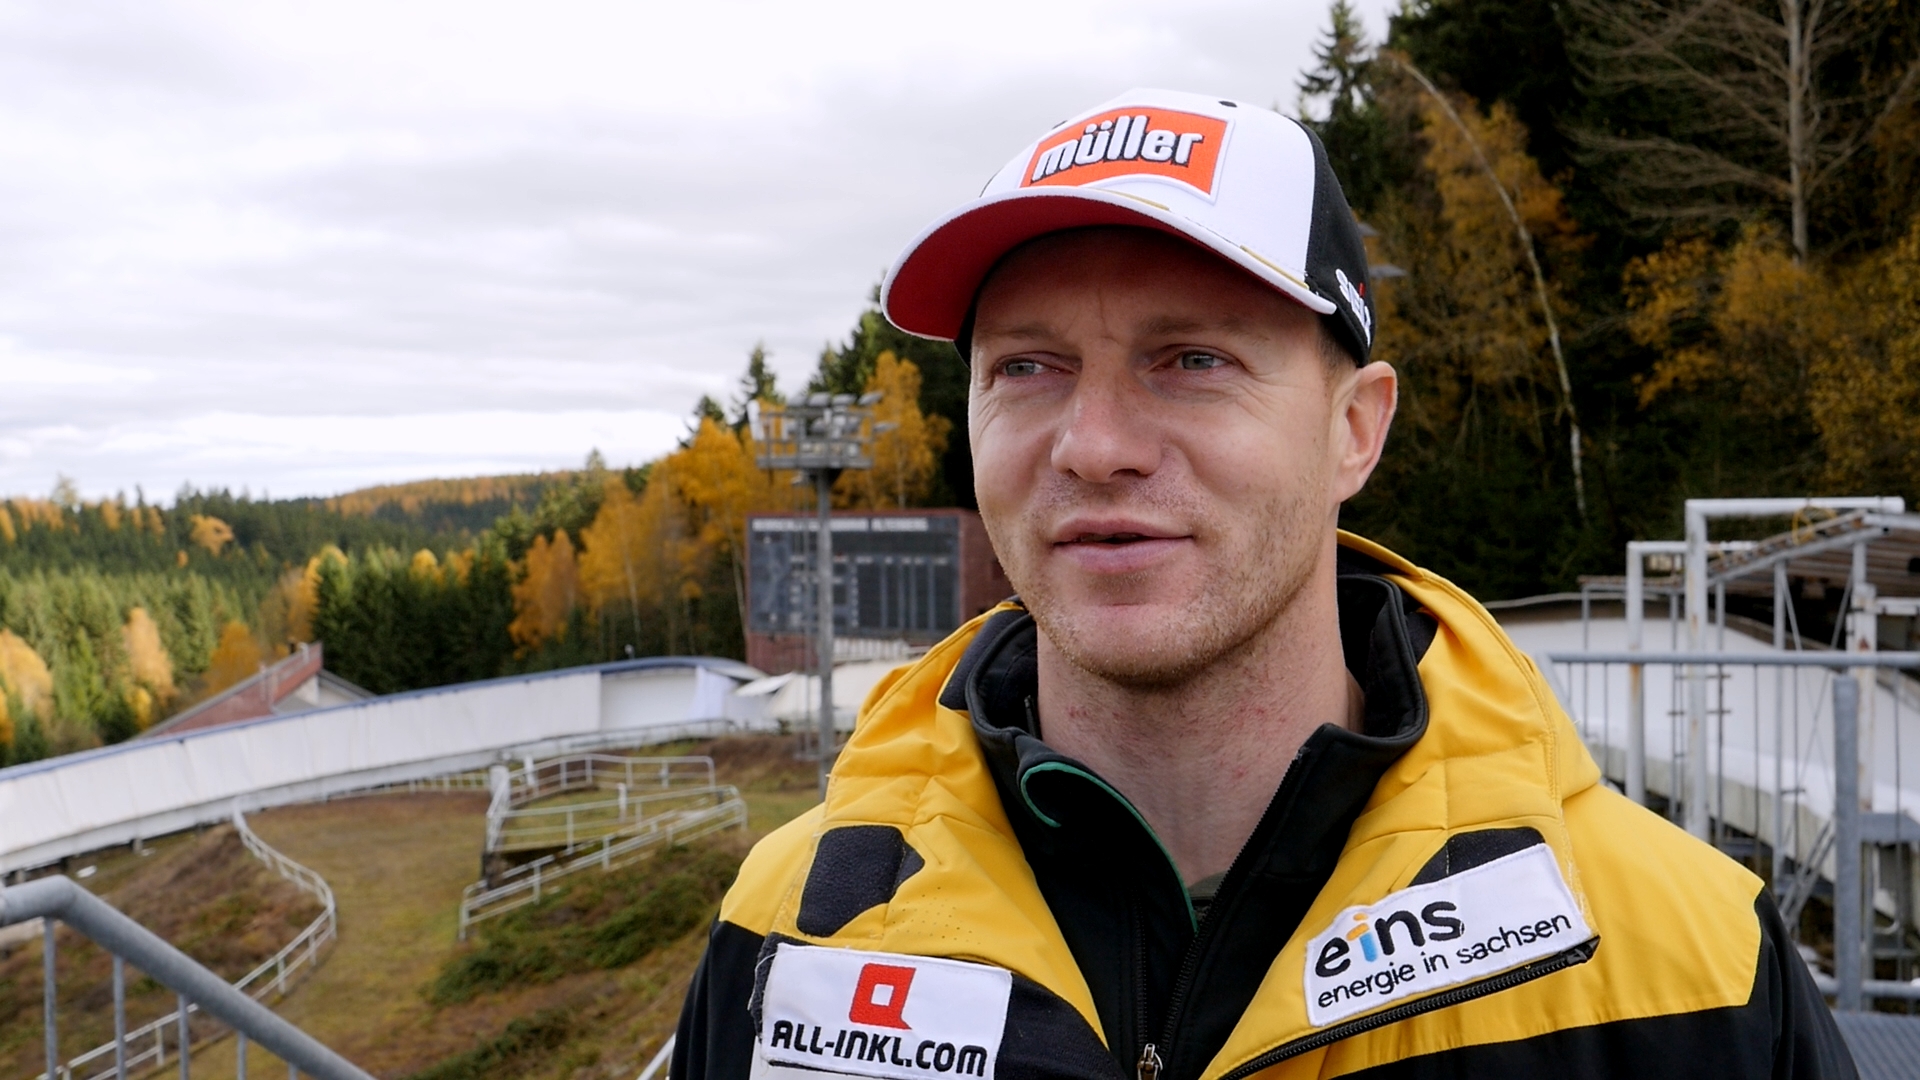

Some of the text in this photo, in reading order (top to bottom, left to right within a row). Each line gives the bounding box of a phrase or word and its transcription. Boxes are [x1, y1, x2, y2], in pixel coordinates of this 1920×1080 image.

[1031, 114, 1204, 183] müller
[1315, 901, 1465, 977] eins
[1318, 914, 1572, 1008] energie in sachsen
[771, 1020, 988, 1077] ALL-INKL.COM
